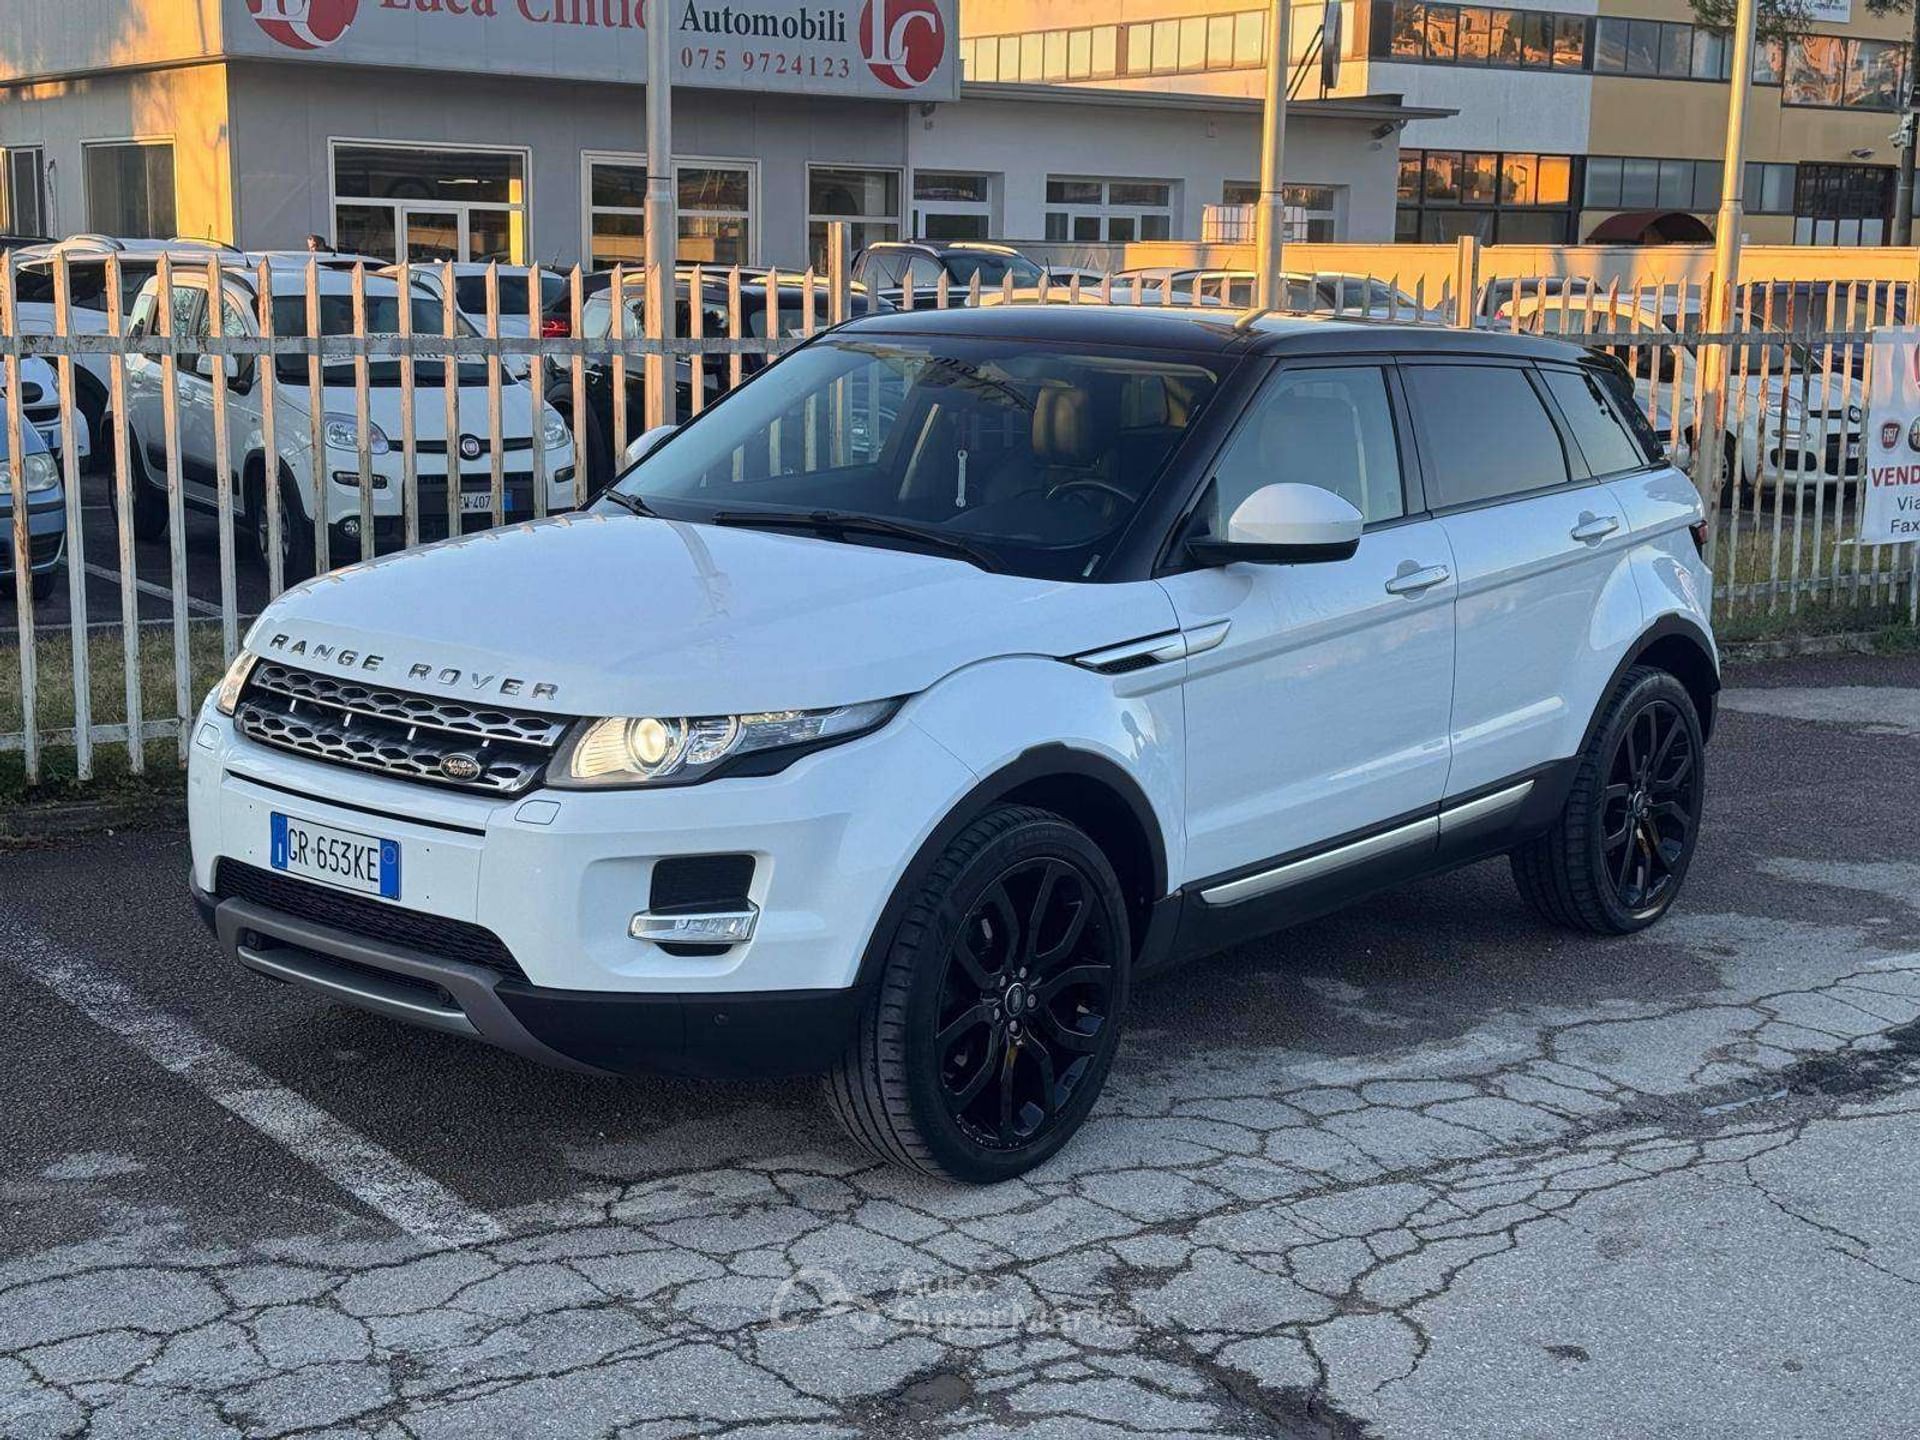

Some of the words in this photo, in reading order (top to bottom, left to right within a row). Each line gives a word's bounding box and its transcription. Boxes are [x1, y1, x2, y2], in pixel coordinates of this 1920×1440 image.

[679, 0, 848, 43] Automobili
[681, 47, 727, 71] 075
[742, 51, 850, 78] 9724123
[1890, 517, 1920, 534] Fax
[269, 633, 385, 672] RANGE
[408, 662, 560, 701] ROVER
